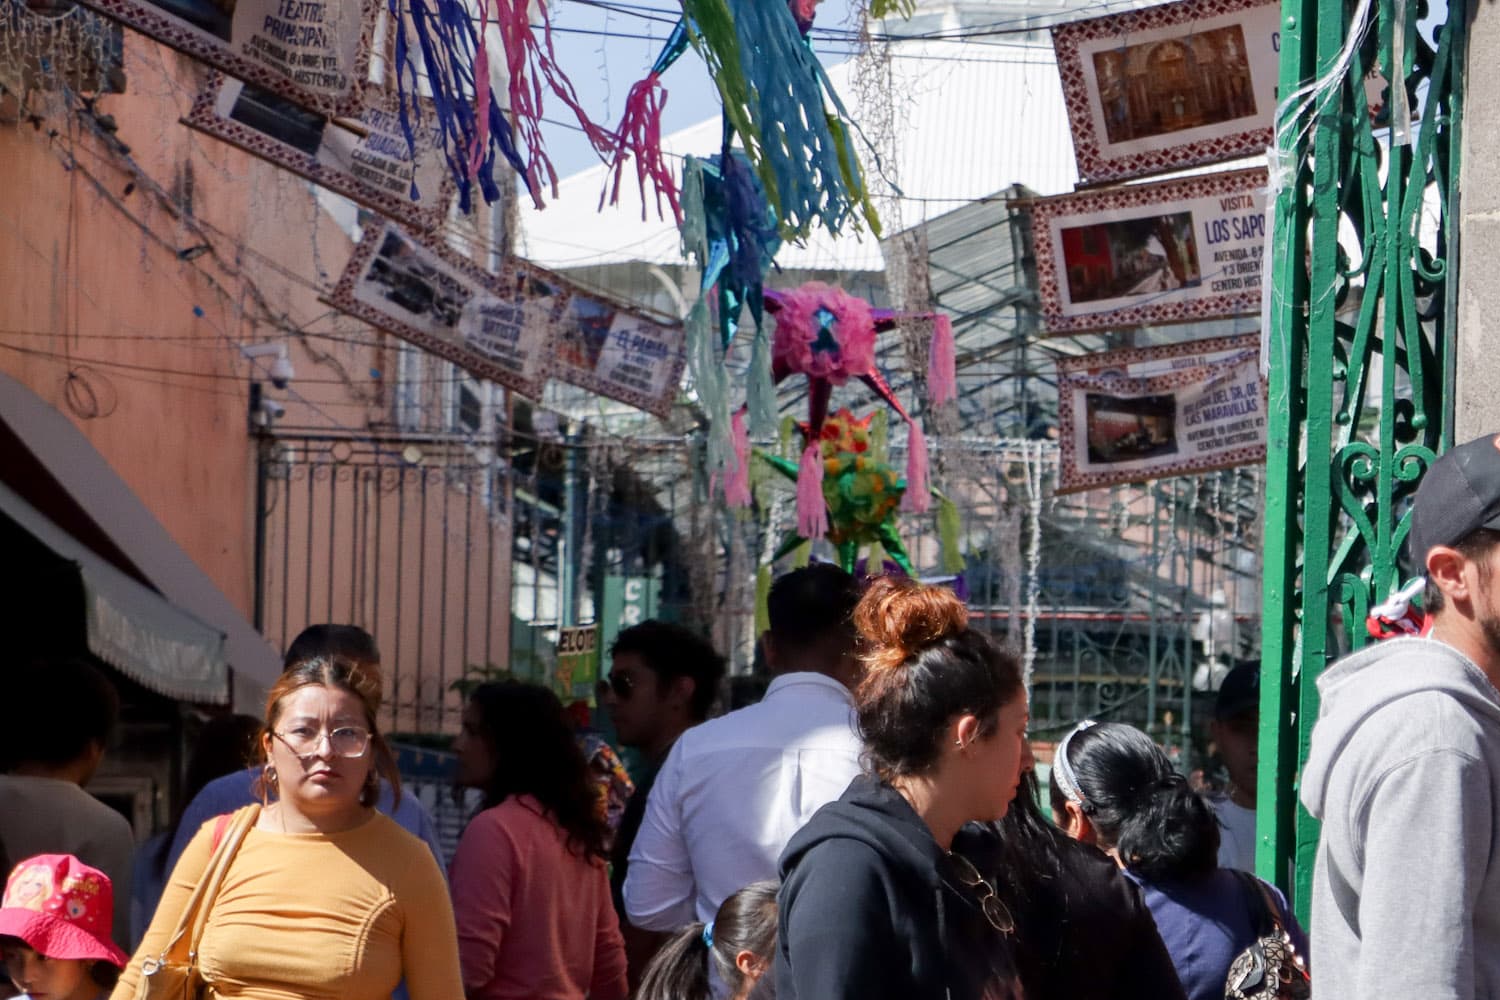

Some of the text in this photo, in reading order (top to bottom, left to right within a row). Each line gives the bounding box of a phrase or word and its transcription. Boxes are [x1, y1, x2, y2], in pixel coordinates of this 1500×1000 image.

[1220, 195, 1255, 212] VISITA
[1205, 214, 1266, 245] LOS SAPO
[1214, 248, 1248, 262] AVENIDA
[1236, 260, 1263, 274] ORIEN
[1211, 279, 1243, 293] CENTRO
